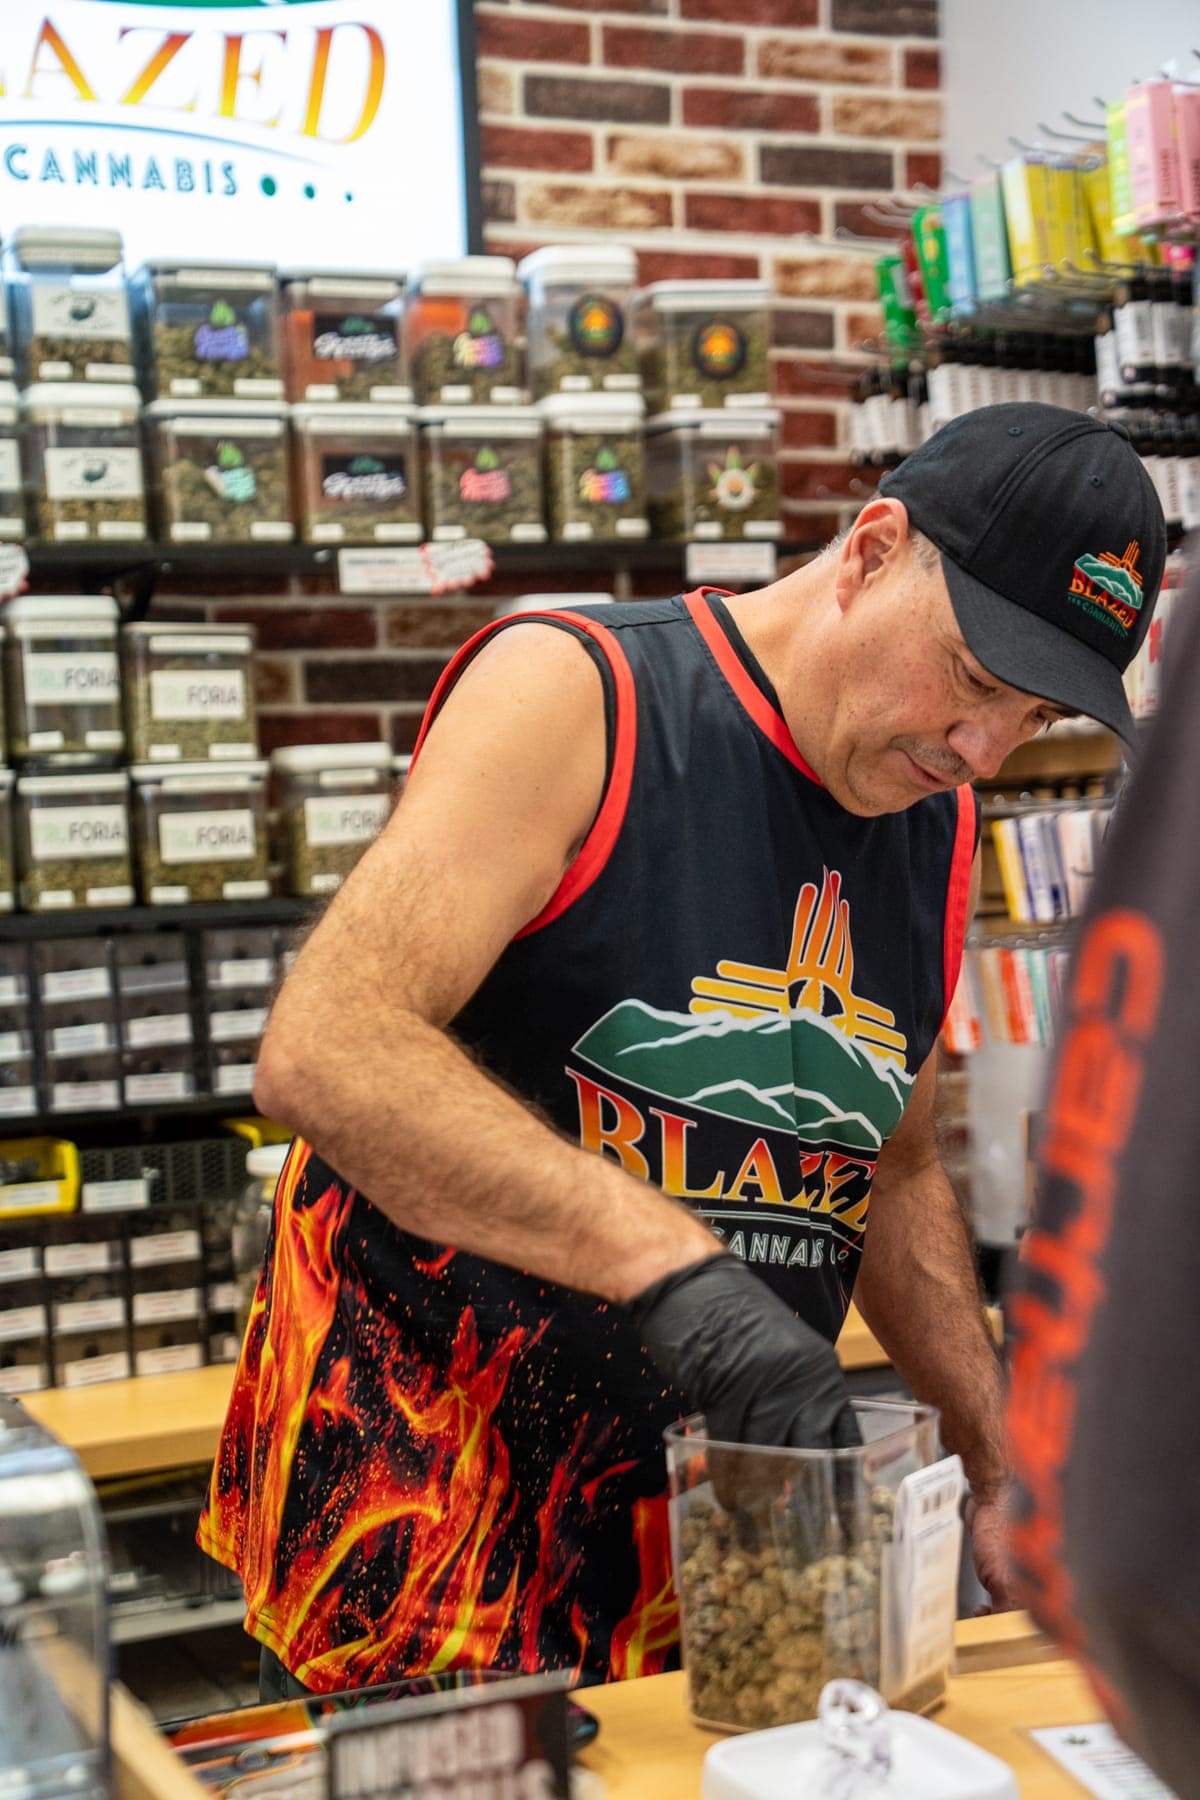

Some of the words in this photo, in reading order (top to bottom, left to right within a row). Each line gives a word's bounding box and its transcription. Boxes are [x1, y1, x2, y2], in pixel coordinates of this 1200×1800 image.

[0, 16, 387, 145] AZED
[3, 142, 239, 197] CANNABIS
[1068, 565, 1138, 629] BLAZED
